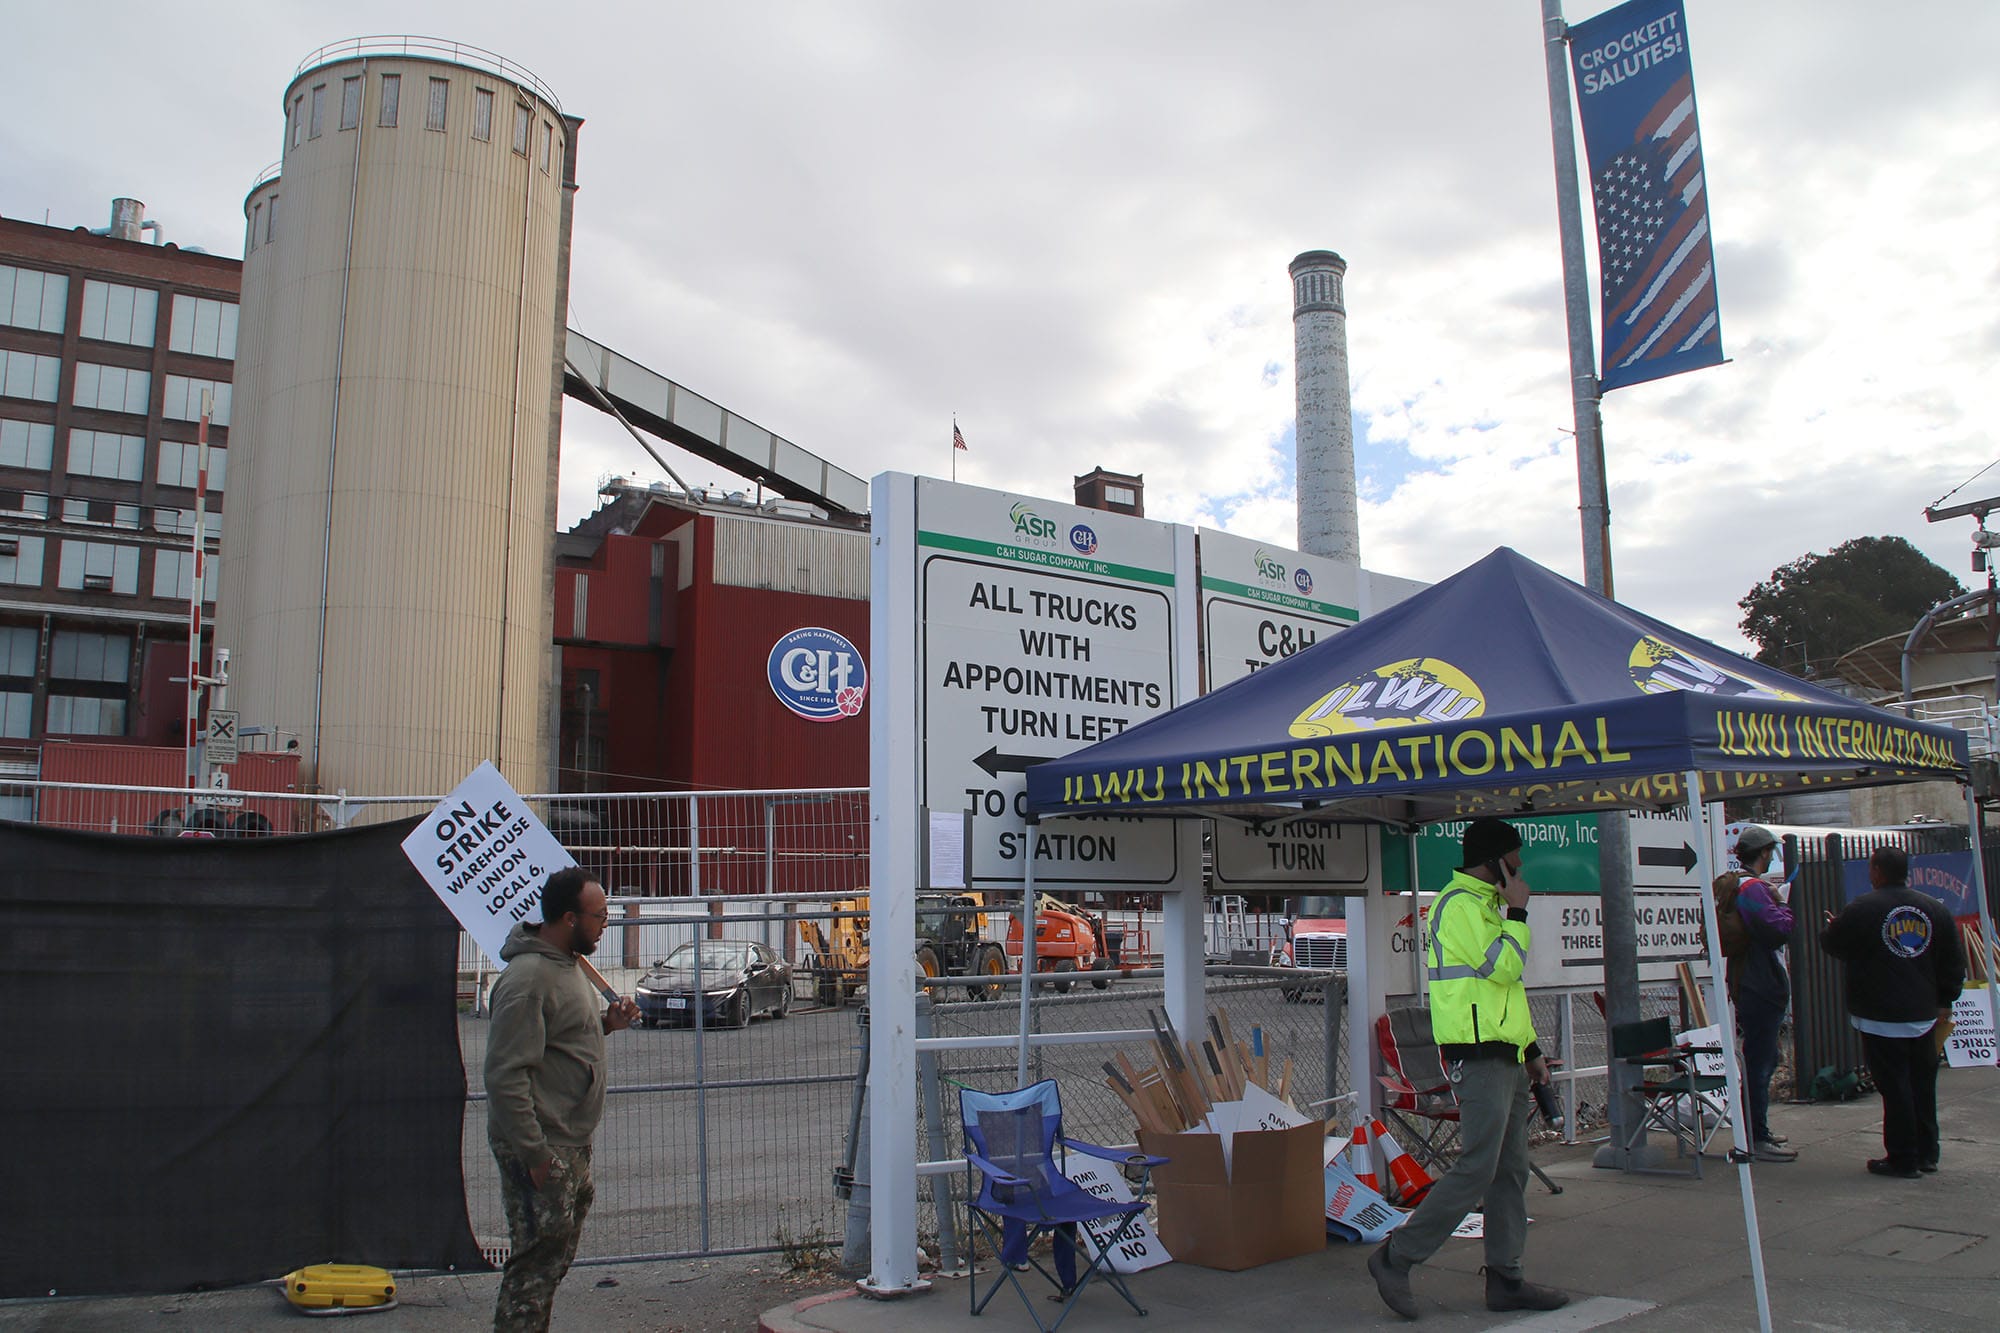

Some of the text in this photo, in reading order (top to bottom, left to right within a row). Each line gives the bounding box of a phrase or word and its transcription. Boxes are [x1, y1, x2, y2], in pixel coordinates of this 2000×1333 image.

[1579, 12, 1677, 70] CROCKETT
[1584, 32, 1683, 95] SALUTES!
[1014, 514, 1057, 540] ASR
[1015, 535, 1057, 547] GROUP
[996, 546, 1111, 575] C&H SUGAR COMPANY, INC.
[1258, 560, 1286, 582] ASR
[969, 582, 1137, 631] ALL TRUCKS
[1020, 629, 1090, 662] WITH
[1258, 620, 1316, 658] C&H
[780, 647, 854, 693] C&H
[943, 661, 1161, 708] APPOINTMENTS
[1305, 677, 1481, 723] ILWU
[981, 706, 1129, 741] TURN LEFT
[1717, 711, 1962, 770] ILWU INTERNATIONAL
[1063, 774, 1165, 806] ILWU
[1181, 716, 1631, 801] INTERNATIONAL
[215, 778, 223, 789] 4
[965, 788, 1005, 817] TO
[436, 800, 477, 842] ON
[437, 800, 513, 875] STRIKE
[447, 816, 531, 895] WAREHOUSE
[1267, 842, 1325, 870] TURN
[477, 848, 528, 895] UNION
[1912, 867, 1924, 886] IN
[486, 864, 545, 916] LOCAL 6,
[1562, 908, 1591, 927] 550
[1890, 918, 1928, 940] ILWU
[1561, 935, 1602, 949] THREE
[1652, 933, 1669, 948] UP,
[1671, 932, 1687, 946] ON
[1960, 1009, 1985, 1017] LOCAL
[1952, 1037, 1997, 1049] STRIKE
[1968, 1049, 1991, 1059] ON
[1072, 1170, 1098, 1184] ILWU
[1350, 1202, 1393, 1231] LABOR
[1119, 1242, 1147, 1262] ON
